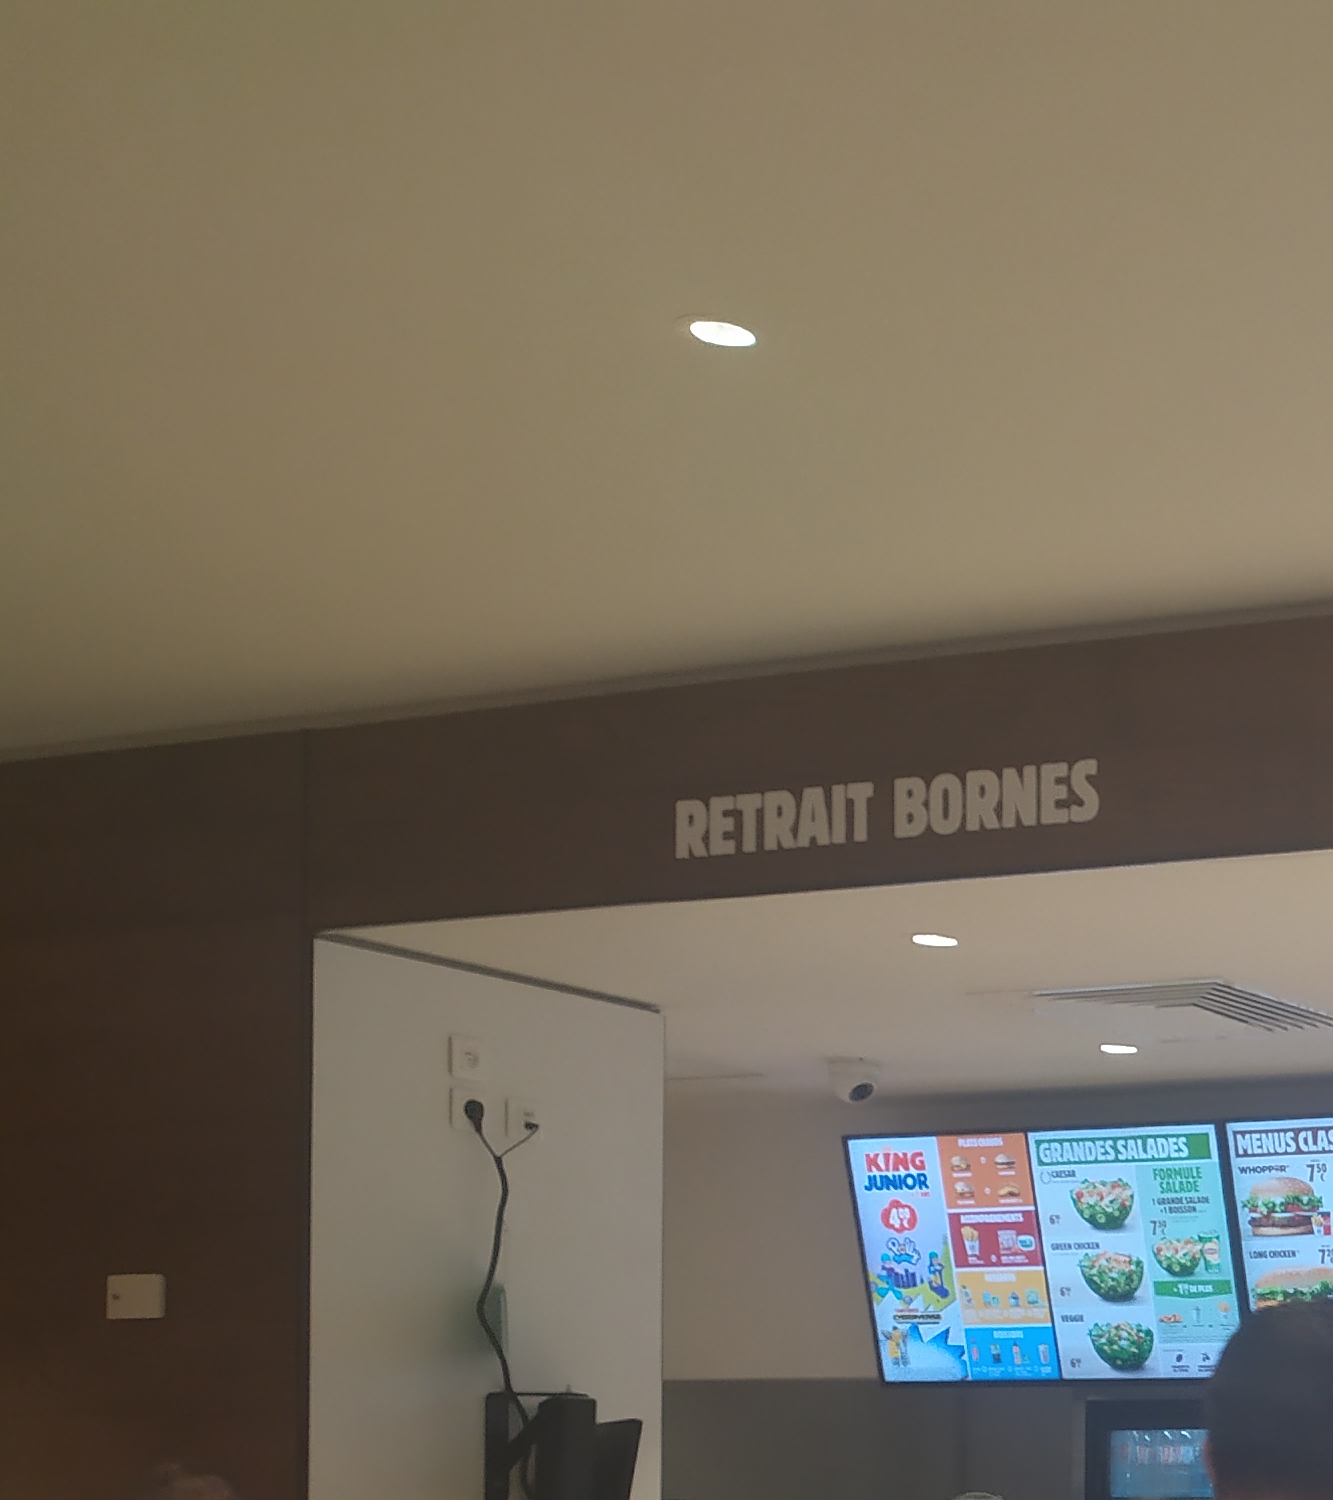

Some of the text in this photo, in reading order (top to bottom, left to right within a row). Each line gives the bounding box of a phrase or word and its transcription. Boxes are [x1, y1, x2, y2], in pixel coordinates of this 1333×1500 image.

[674, 758, 1099, 859] RETRAIT BORNES
[1039, 1138, 1189, 1163] GRANDES SALADES
[1237, 1131, 1297, 1155] MENUS
[865, 1152, 926, 1172] KING
[864, 1173, 929, 1191] JUNIOR
[1153, 1167, 1202, 1180] FORMULE
[1160, 1180, 1199, 1194] SALADE
[1061, 1314, 1084, 1322] VEGGIE
